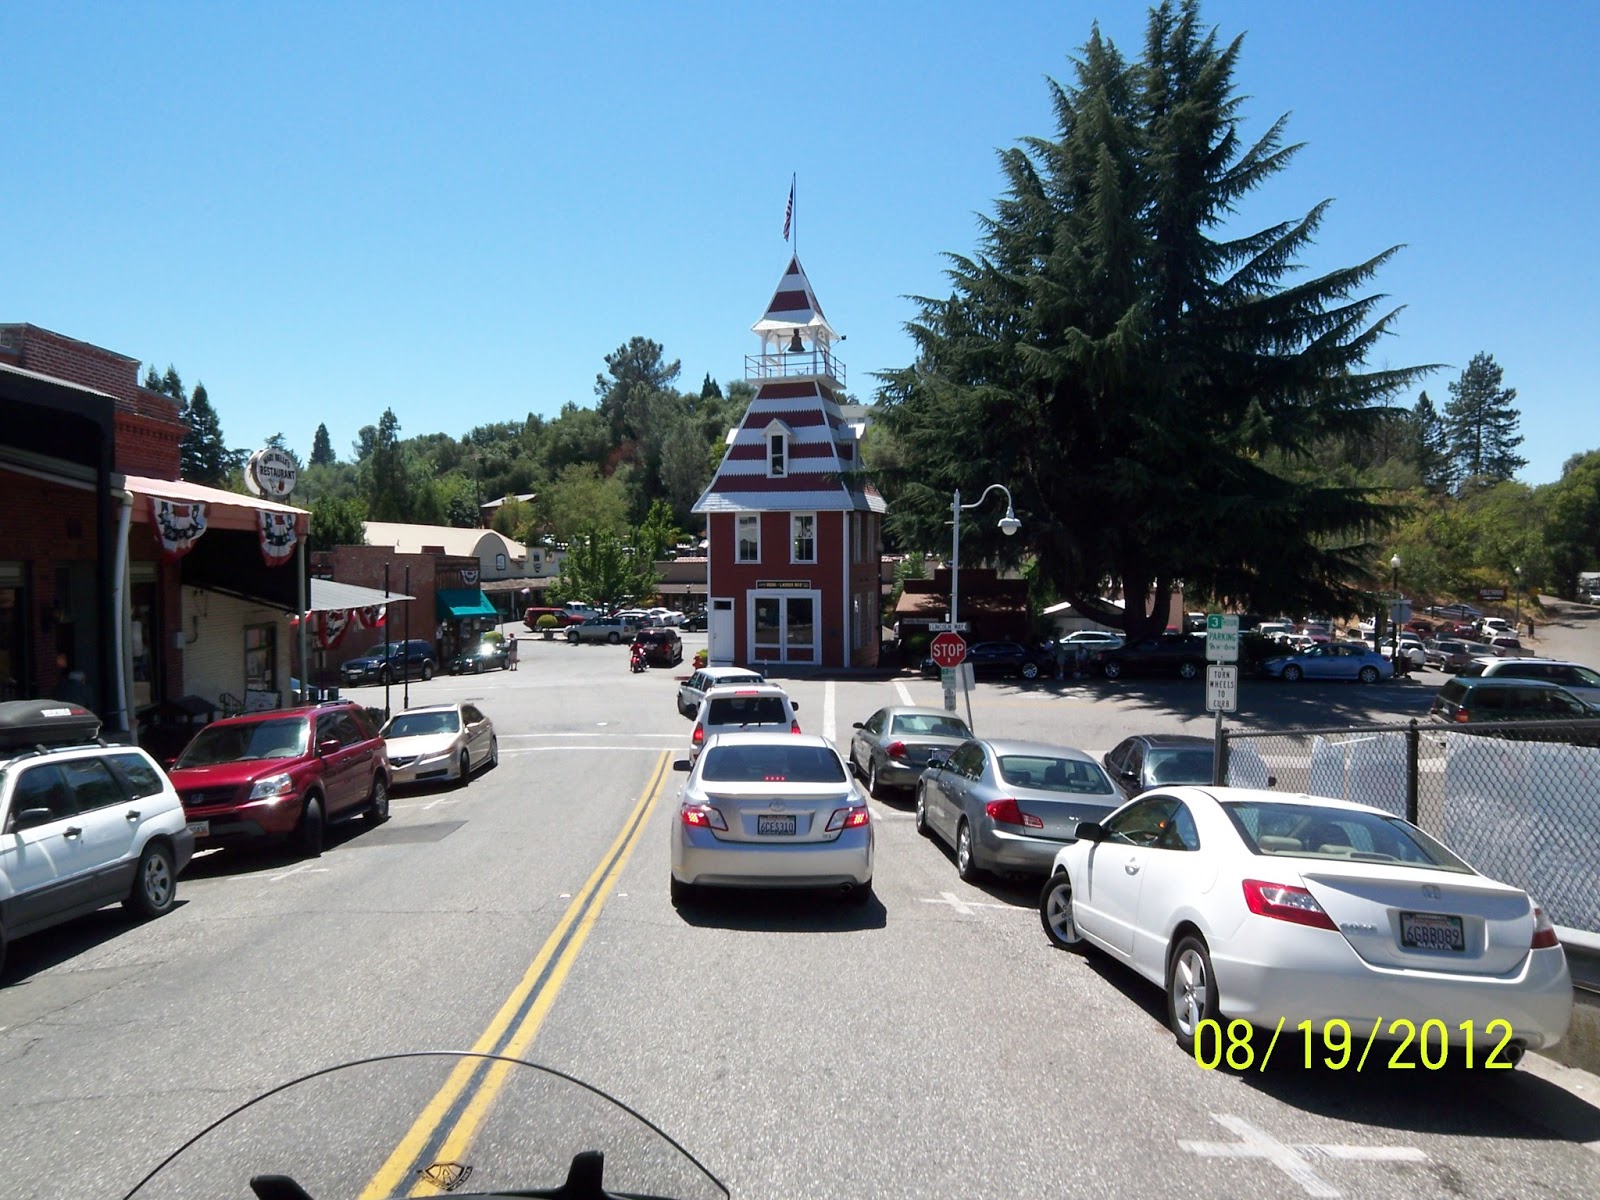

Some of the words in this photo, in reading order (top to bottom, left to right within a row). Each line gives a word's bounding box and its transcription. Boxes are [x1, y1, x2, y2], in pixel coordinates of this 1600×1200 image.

[260, 465, 295, 480] RESTAURANT
[1211, 617, 1219, 628] 3
[1209, 633, 1237, 642] PARKING
[933, 644, 964, 657] STOP
[1214, 671, 1230, 679] TURN
[1210, 681, 1235, 689] WHEELS
[1218, 690, 1226, 698] TO
[1213, 700, 1230, 708] CURB
[761, 822, 794, 833] 6CES310
[1406, 926, 1460, 944] 6GBB089
[1417, 942, 1453, 951] MAITA
